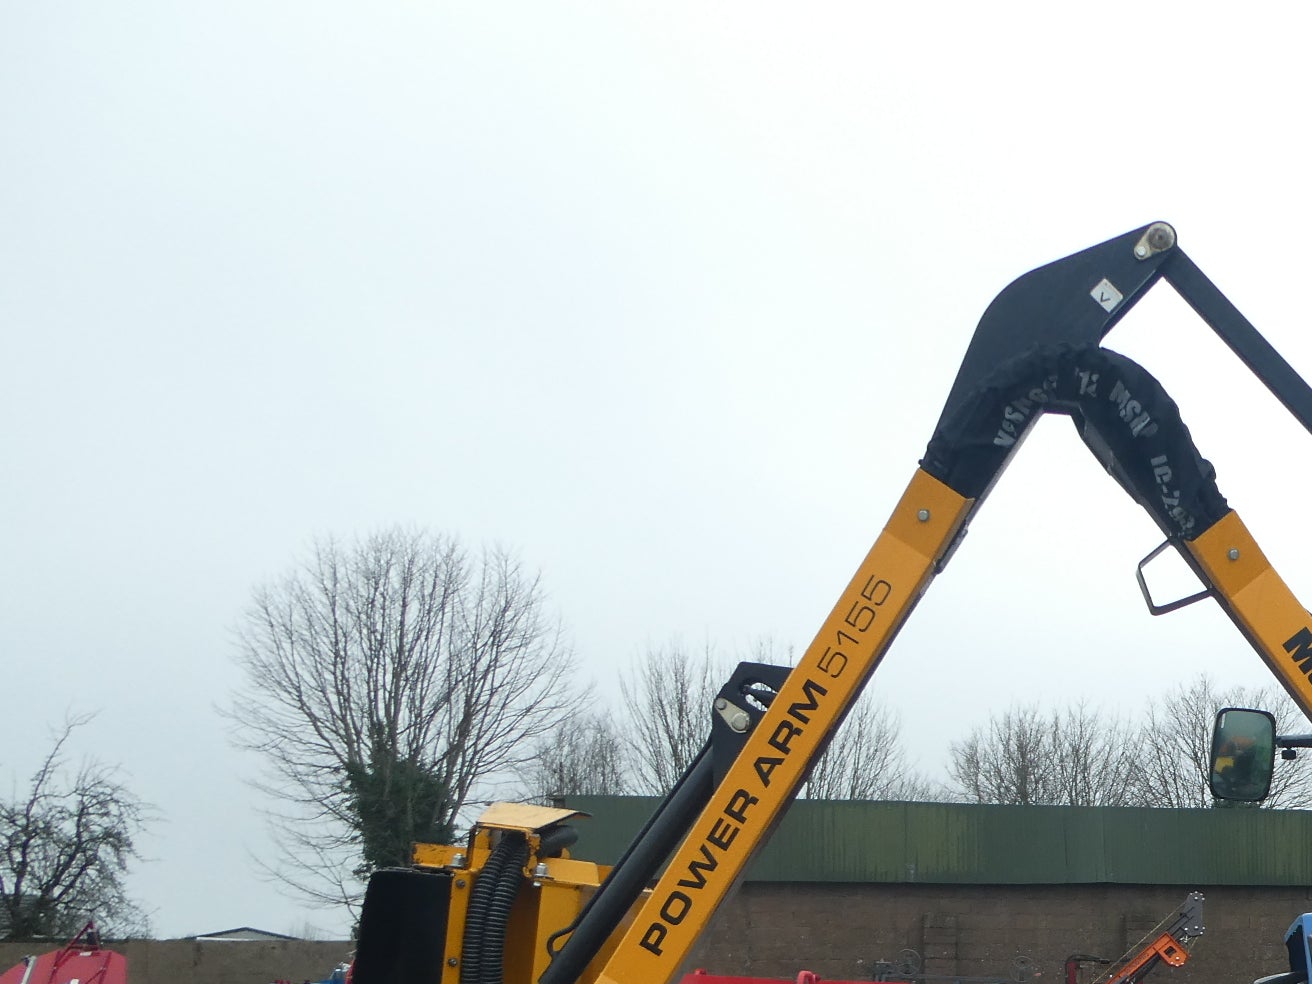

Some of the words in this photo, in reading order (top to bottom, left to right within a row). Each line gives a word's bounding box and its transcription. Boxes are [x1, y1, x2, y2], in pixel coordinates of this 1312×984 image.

[639, 788, 759, 957] POWER
[753, 679, 828, 789] ARM
[817, 574, 893, 679] 5155
